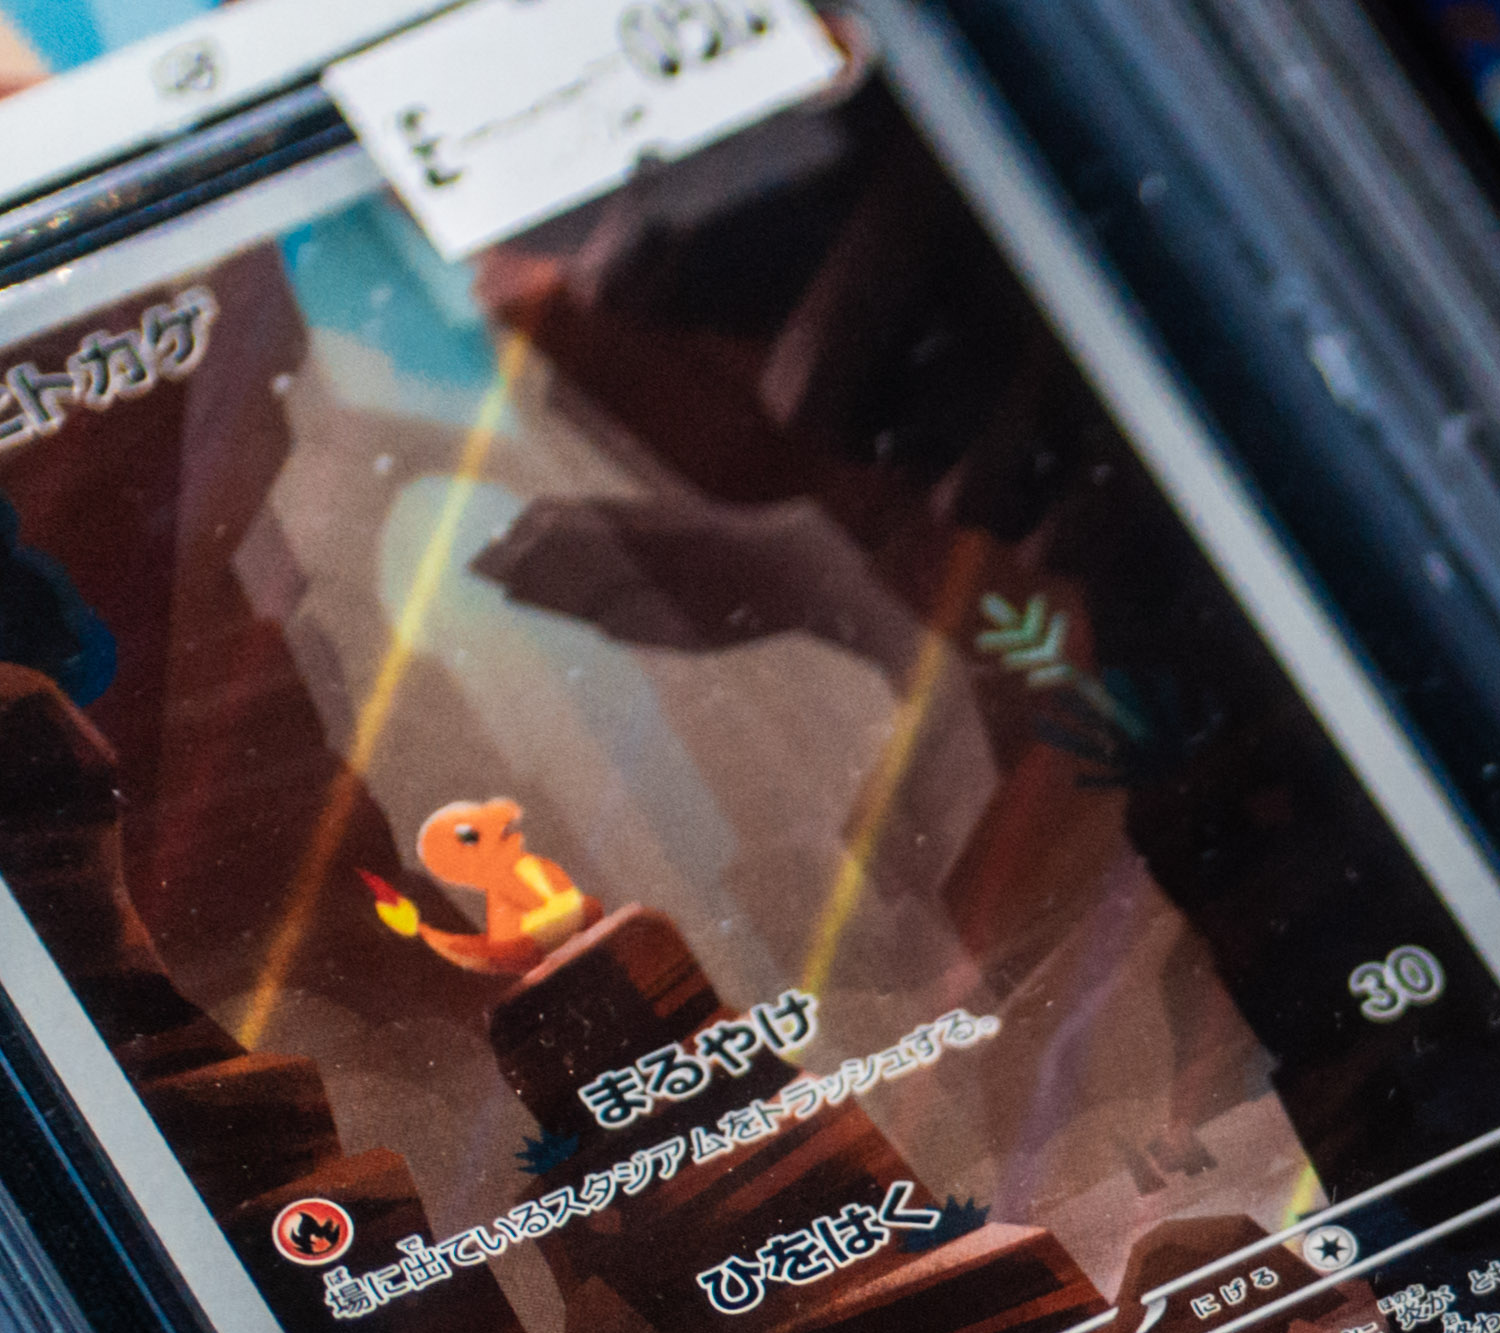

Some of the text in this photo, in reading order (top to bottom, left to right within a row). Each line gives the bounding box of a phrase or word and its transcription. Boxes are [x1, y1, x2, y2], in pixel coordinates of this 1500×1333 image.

[1347, 943, 1445, 1023] 30
[578, 988, 818, 1128] まるやけ
[696, 1180, 940, 1315] ひをはく
[1190, 1266, 1279, 1320] にげる
